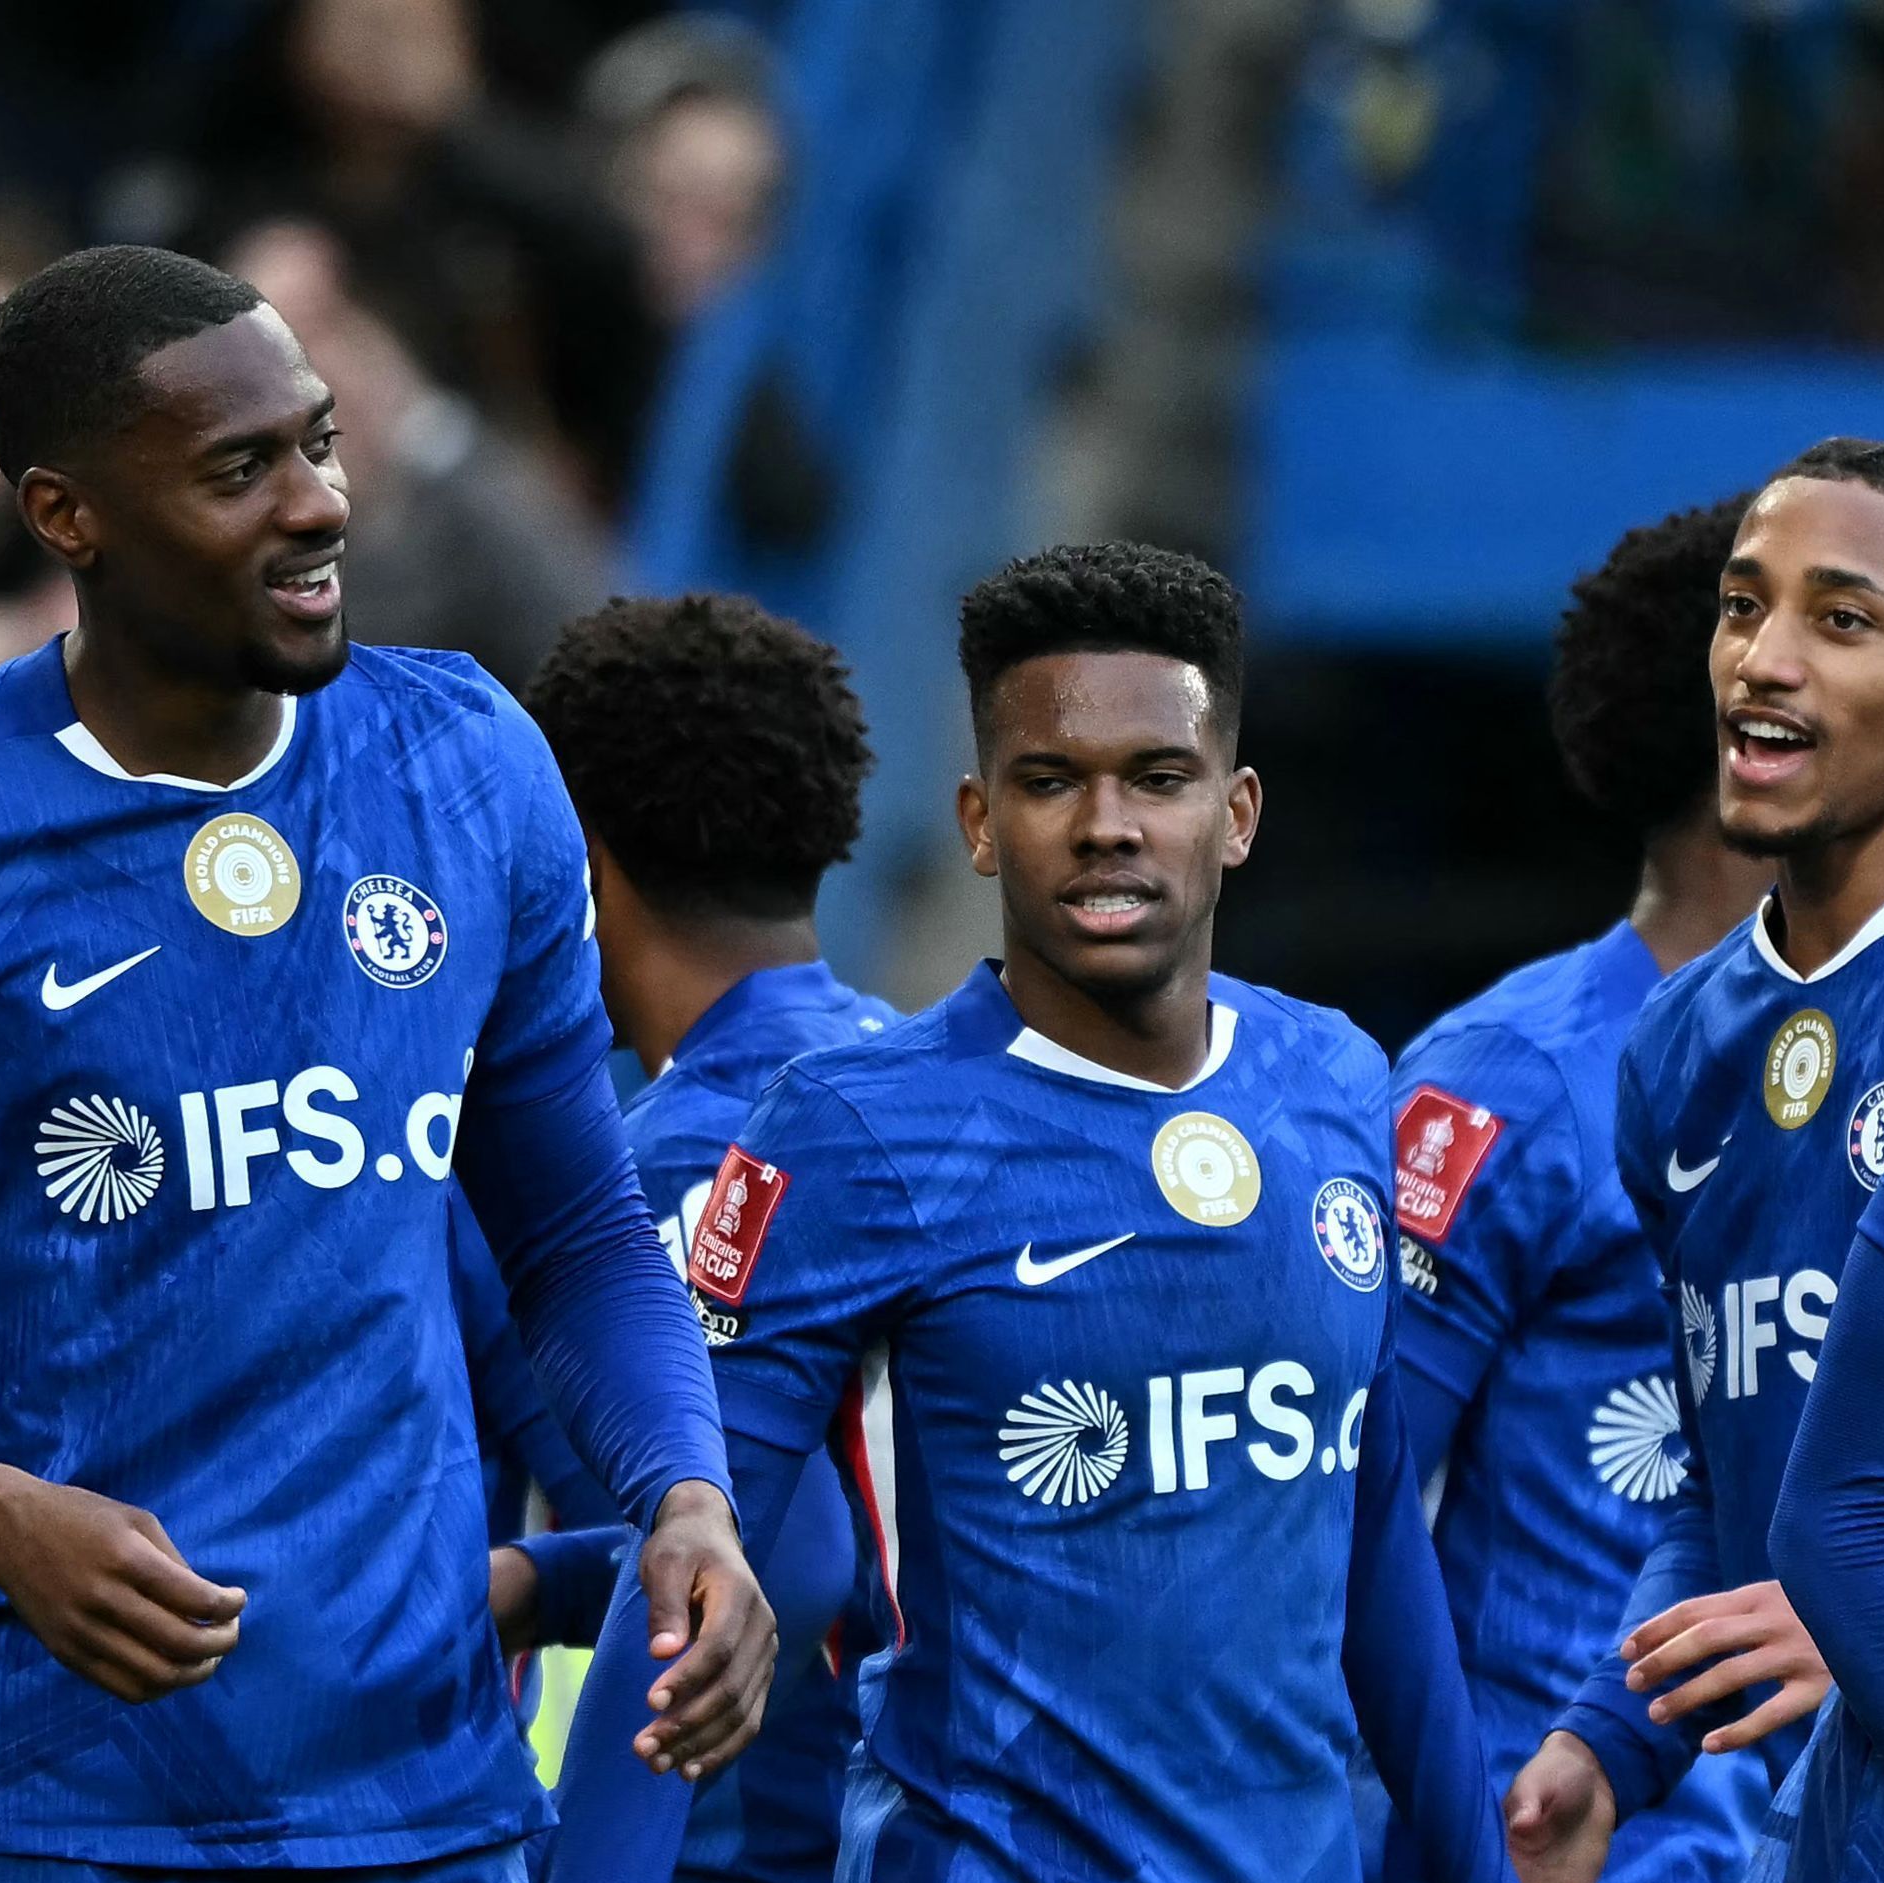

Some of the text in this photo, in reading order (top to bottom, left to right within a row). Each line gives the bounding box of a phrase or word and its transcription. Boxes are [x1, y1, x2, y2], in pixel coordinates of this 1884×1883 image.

[195, 824, 290, 893] WORLD CHAMPIONS
[352, 879, 415, 904] CHELSEA
[229, 906, 274, 926] FIFA
[1772, 1030, 1794, 1086] WORLD
[1782, 1101, 1808, 1120] FIFA
[1319, 1183, 1364, 1210] CHELSEA
[1396, 1167, 1447, 1204] mirates
[1399, 1191, 1441, 1220] CUP
[700, 1227, 744, 1264] Emirates
[705, 1255, 738, 1281] CUP
